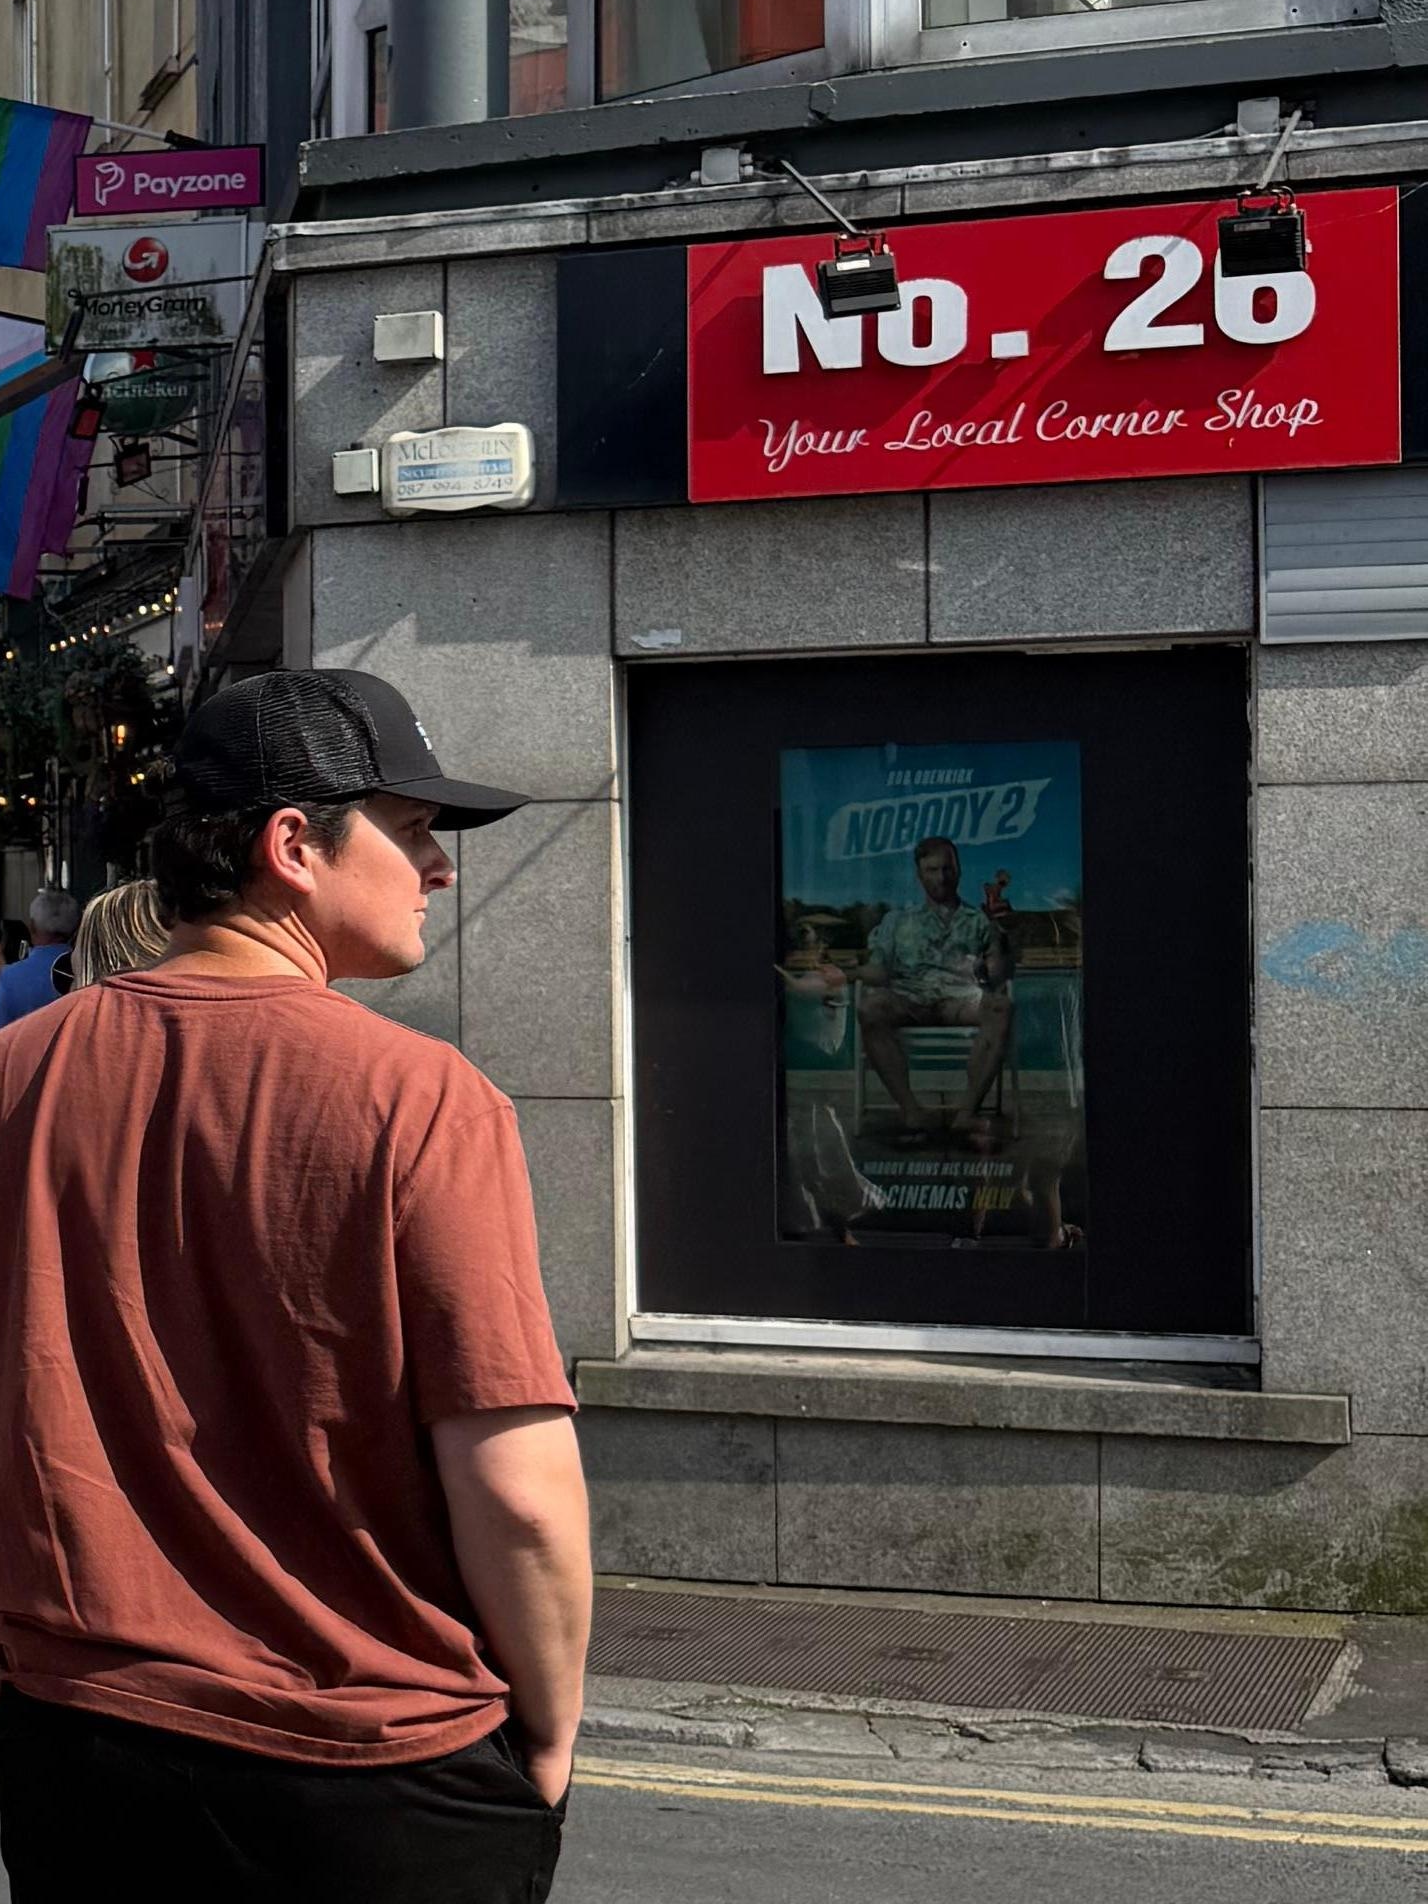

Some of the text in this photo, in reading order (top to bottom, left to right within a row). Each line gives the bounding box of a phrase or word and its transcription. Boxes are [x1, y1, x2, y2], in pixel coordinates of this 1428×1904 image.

[133, 172, 246, 197] Payzone
[82, 296, 206, 318] MoneyGram
[762, 234, 1317, 375] No. 26
[757, 389, 1324, 473] Your Local Corner Shop
[842, 786, 1026, 856] NOBODY 2
[886, 1184, 969, 1209] CINEMAS
[970, 1185, 1017, 1210] NOW
